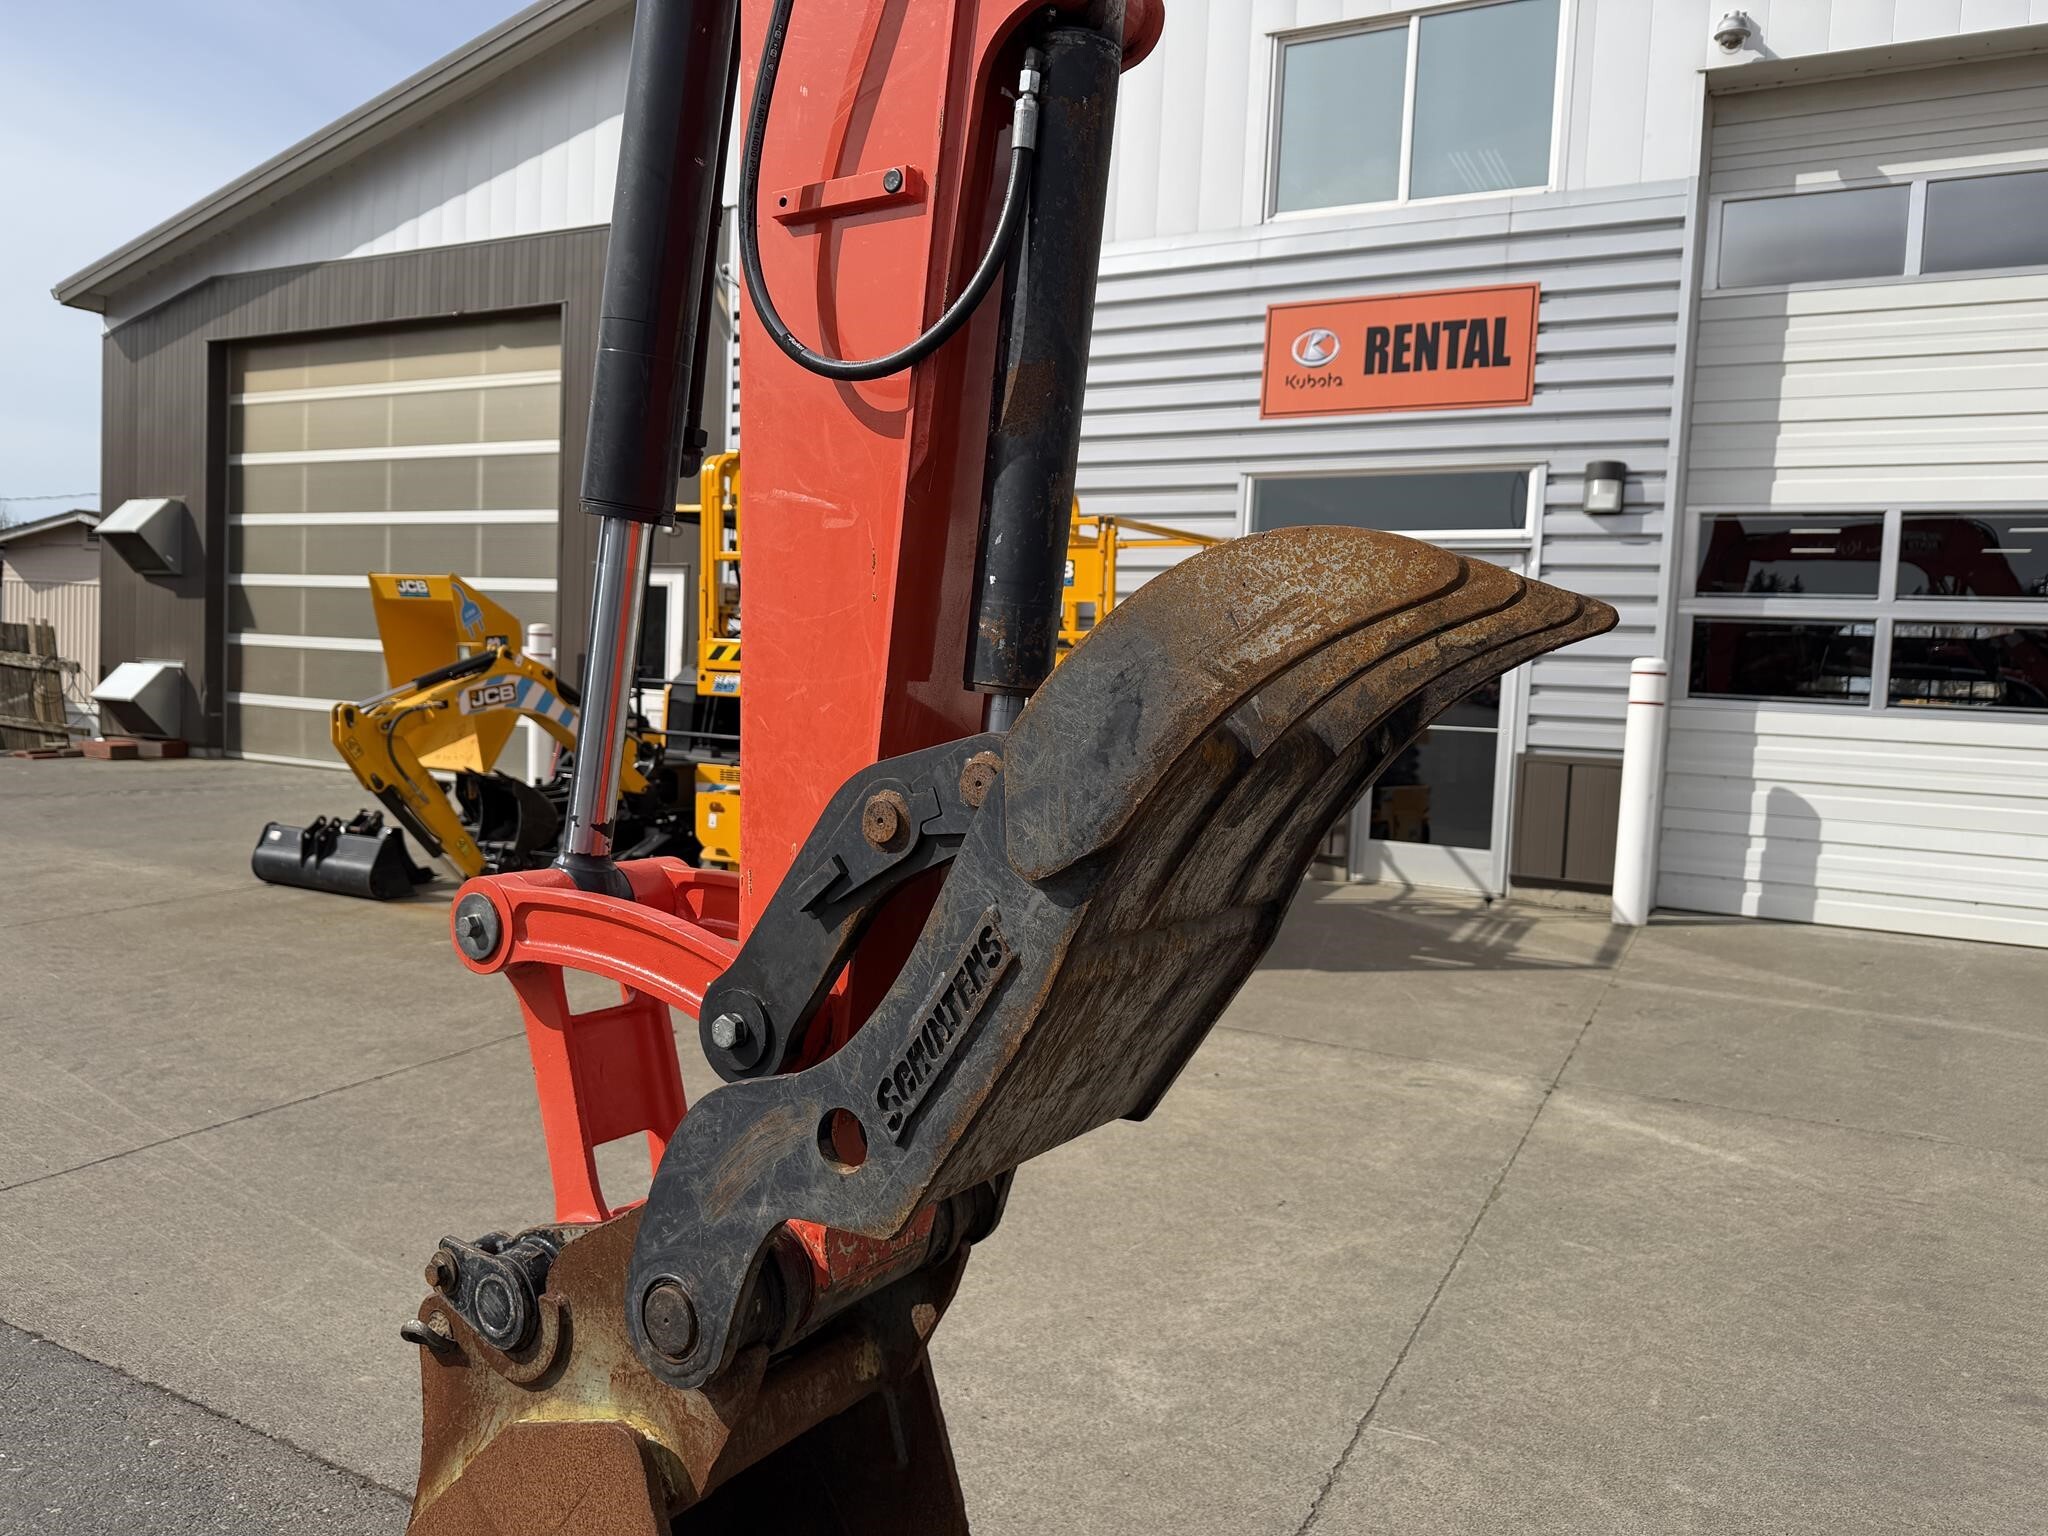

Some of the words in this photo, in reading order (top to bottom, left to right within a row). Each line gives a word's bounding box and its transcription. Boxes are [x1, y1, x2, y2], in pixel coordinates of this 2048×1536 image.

[1364, 317, 1511, 375] RENTAL
[1285, 372, 1343, 389] Kubota
[398, 580, 428, 592] JCB
[471, 685, 515, 707] JCB
